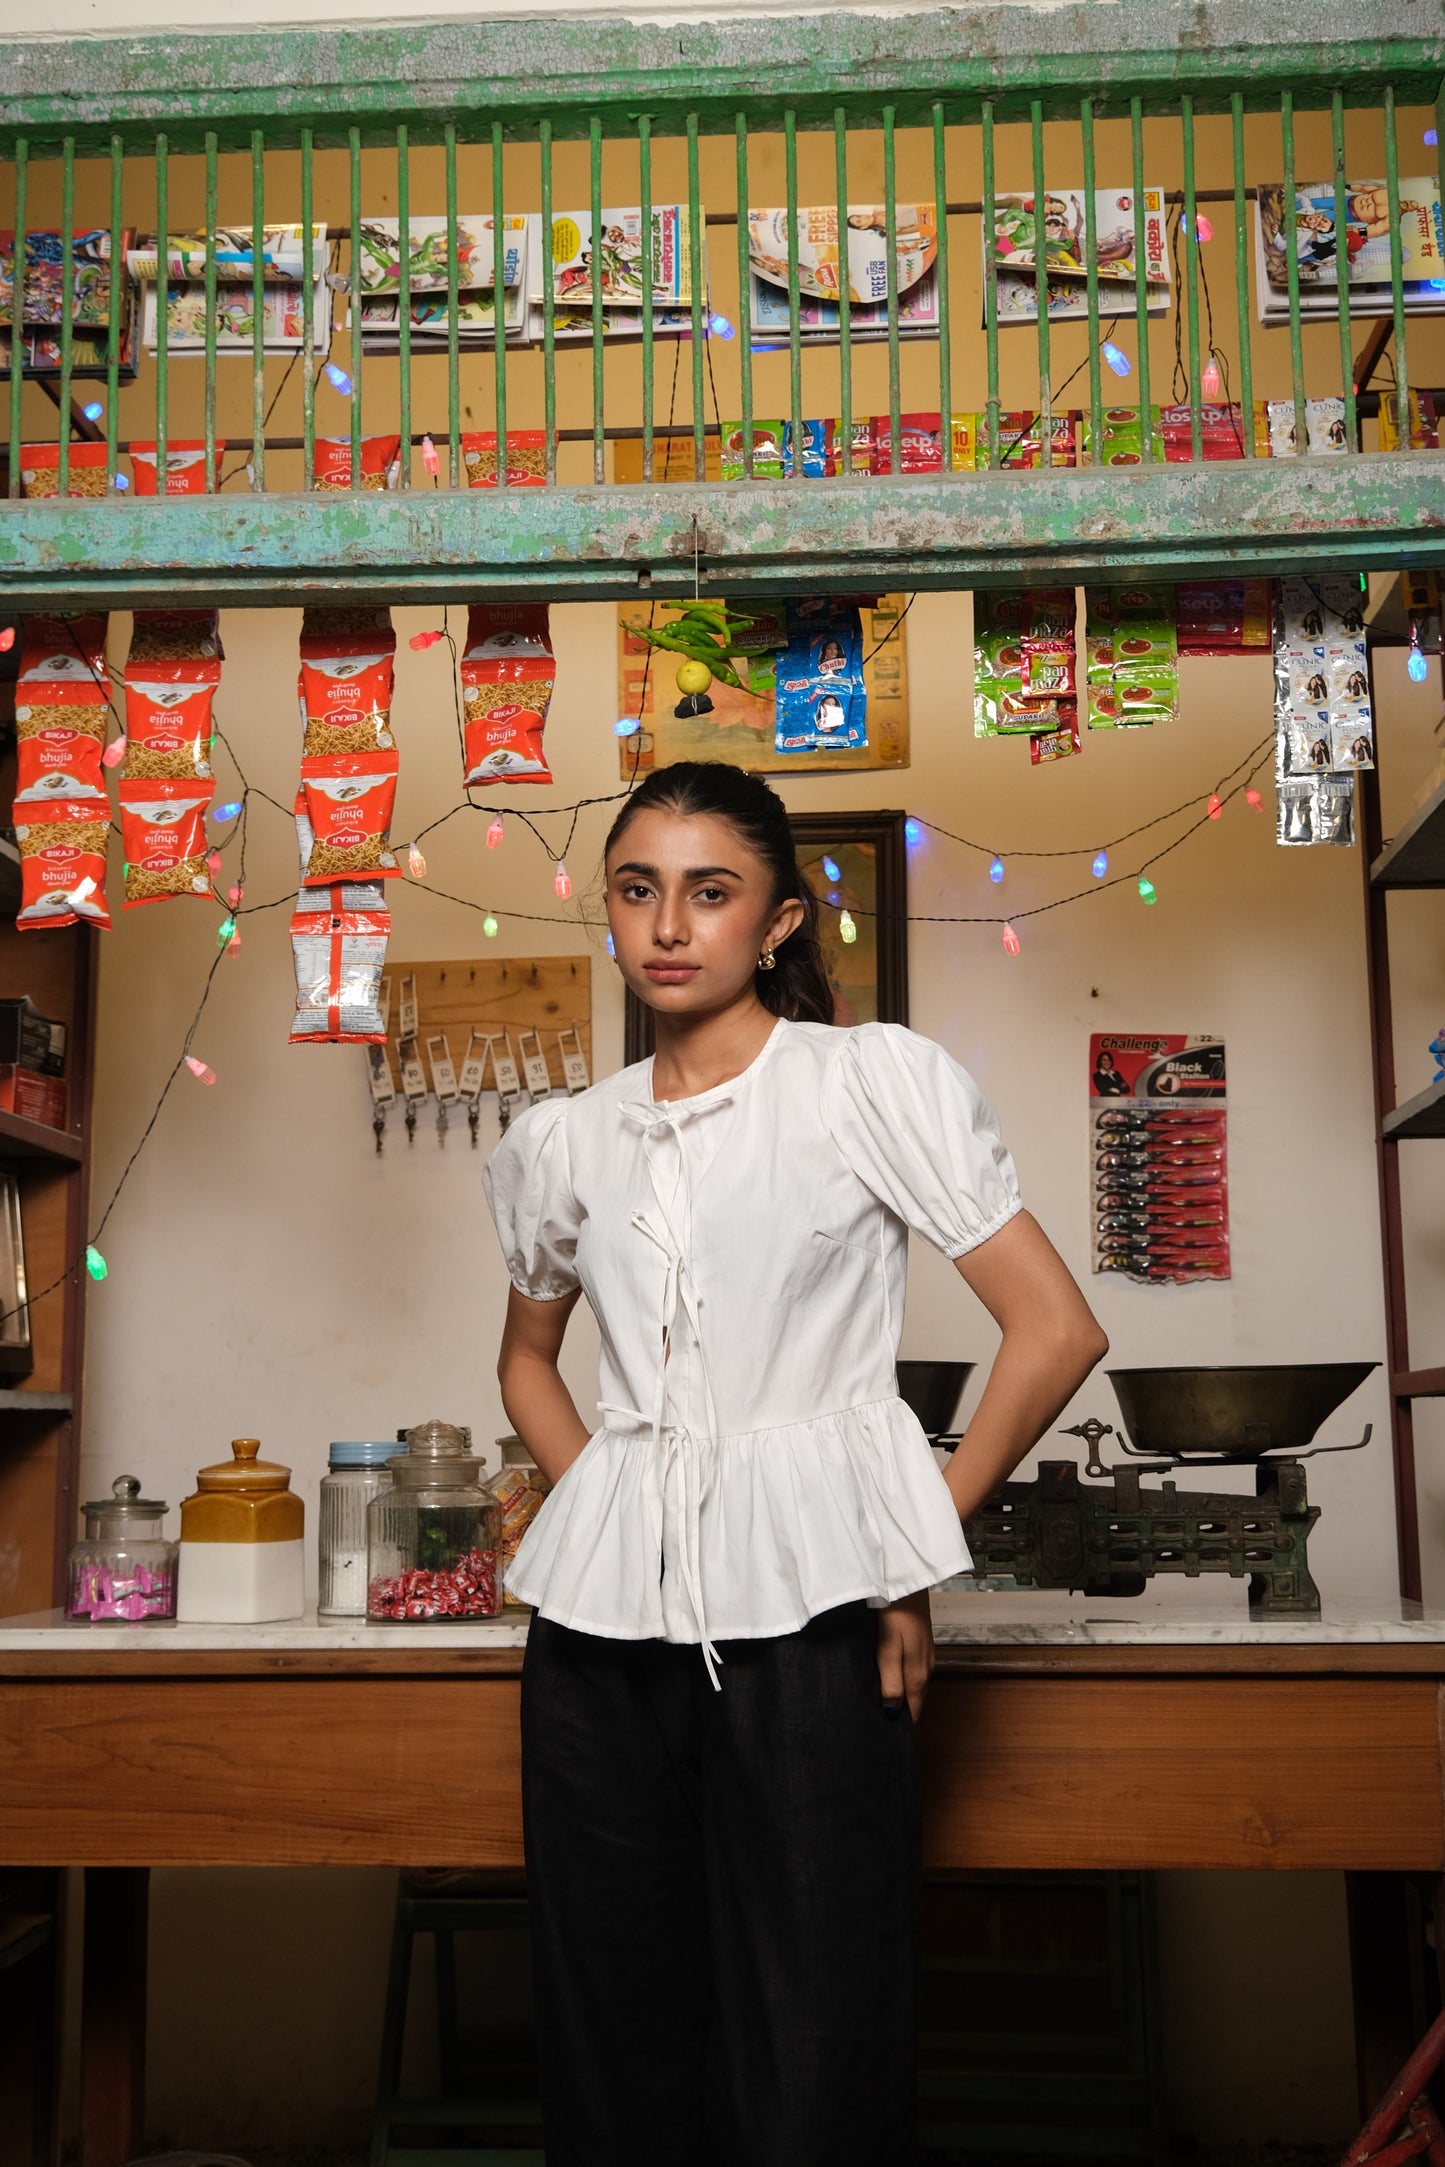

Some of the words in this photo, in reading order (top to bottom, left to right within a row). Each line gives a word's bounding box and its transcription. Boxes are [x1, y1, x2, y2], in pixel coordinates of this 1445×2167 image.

[1160, 410, 1221, 425] losup
[953, 431, 969, 446] 10
[1043, 665, 1069, 682] pan
[1029, 679, 1067, 690] maz
[327, 687, 361, 700] bhujia
[330, 713, 358, 723] BIKAJI
[493, 707, 517, 719] BIKAJI
[149, 714, 184, 727] bhujia
[45, 731, 73, 739] BIKAJI
[486, 728, 517, 743] bhujia
[150, 739, 179, 749] BIKAJI
[39, 752, 73, 764] bhujia
[330, 809, 364, 821] bhujia
[144, 834, 178, 847] bhujia
[332, 833, 360, 844] BIKAJI
[46, 849, 75, 858] BIKAJI
[147, 859, 174, 869] BIKAJI
[42, 871, 77, 882] bhujia
[1101, 1038, 1168, 1052] Challenge
[1166, 1062, 1202, 1072] Black
